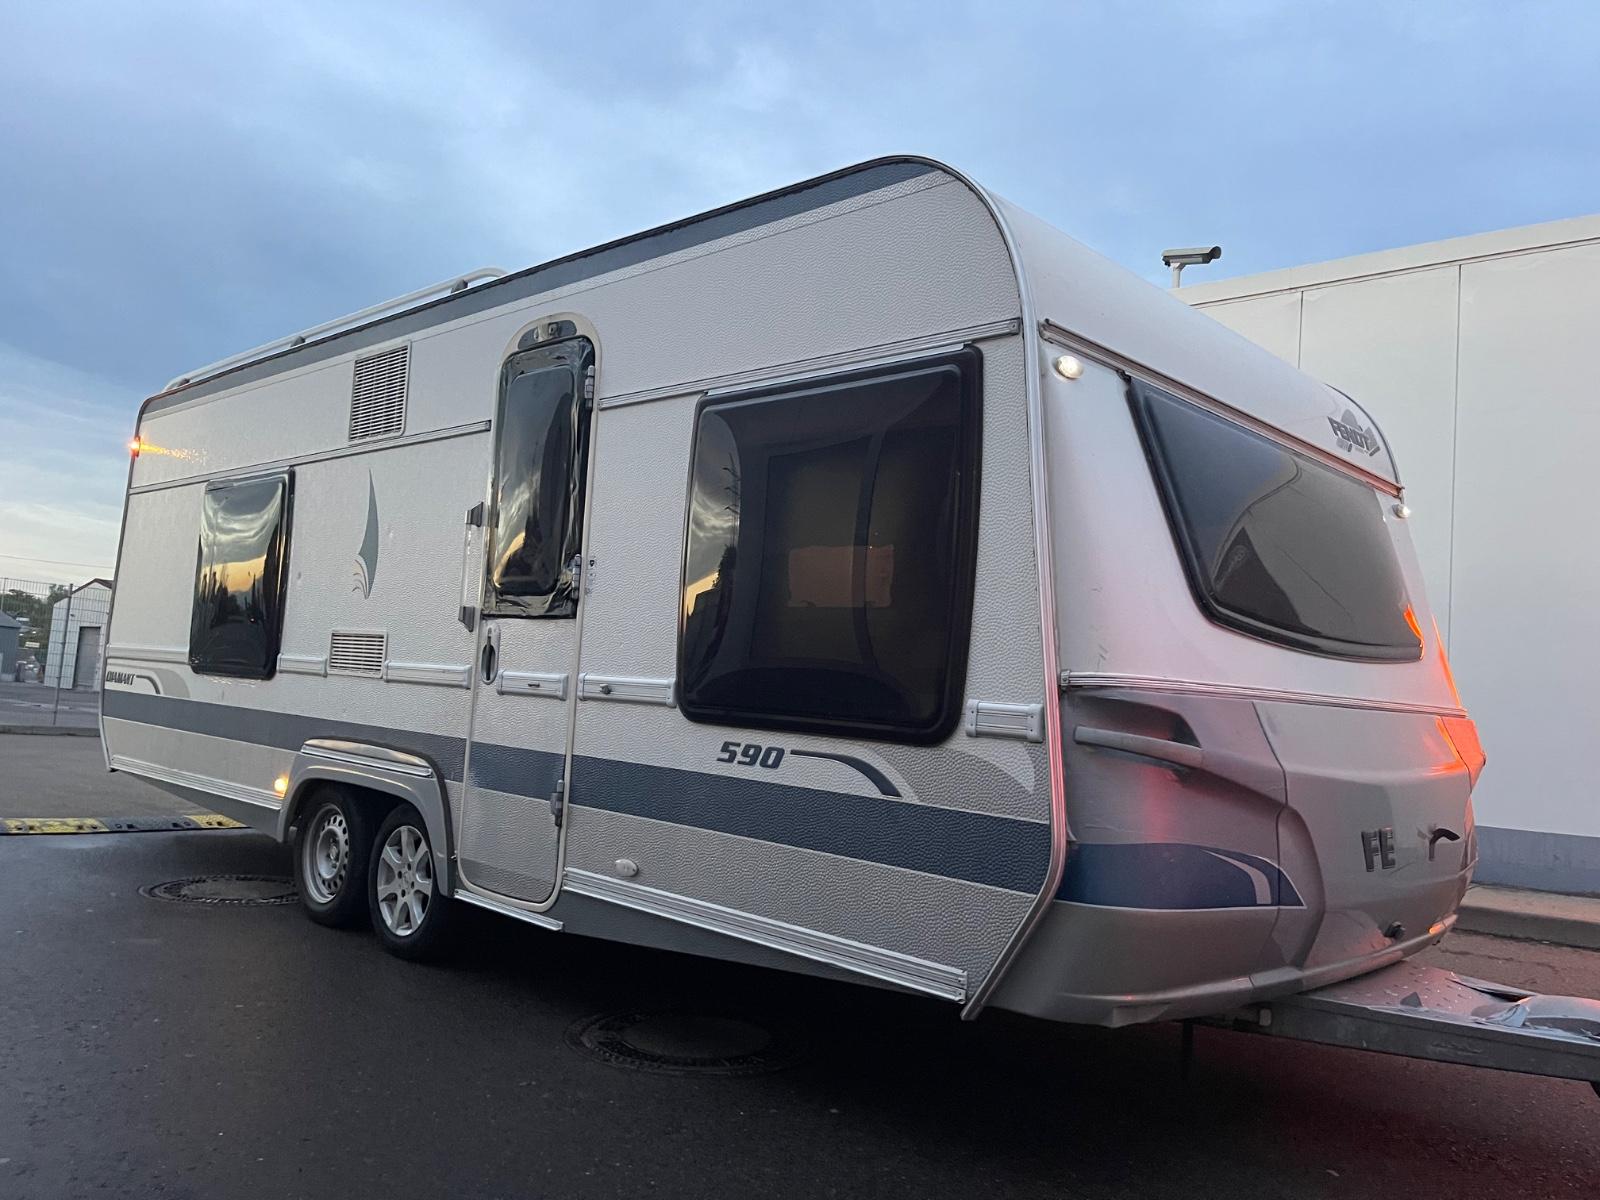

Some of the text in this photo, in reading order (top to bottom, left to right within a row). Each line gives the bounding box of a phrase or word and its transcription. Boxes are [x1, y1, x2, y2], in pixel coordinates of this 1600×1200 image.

[1327, 416, 1370, 451] FENDT
[716, 741, 785, 769] 590
[1361, 828, 1396, 872] FE
